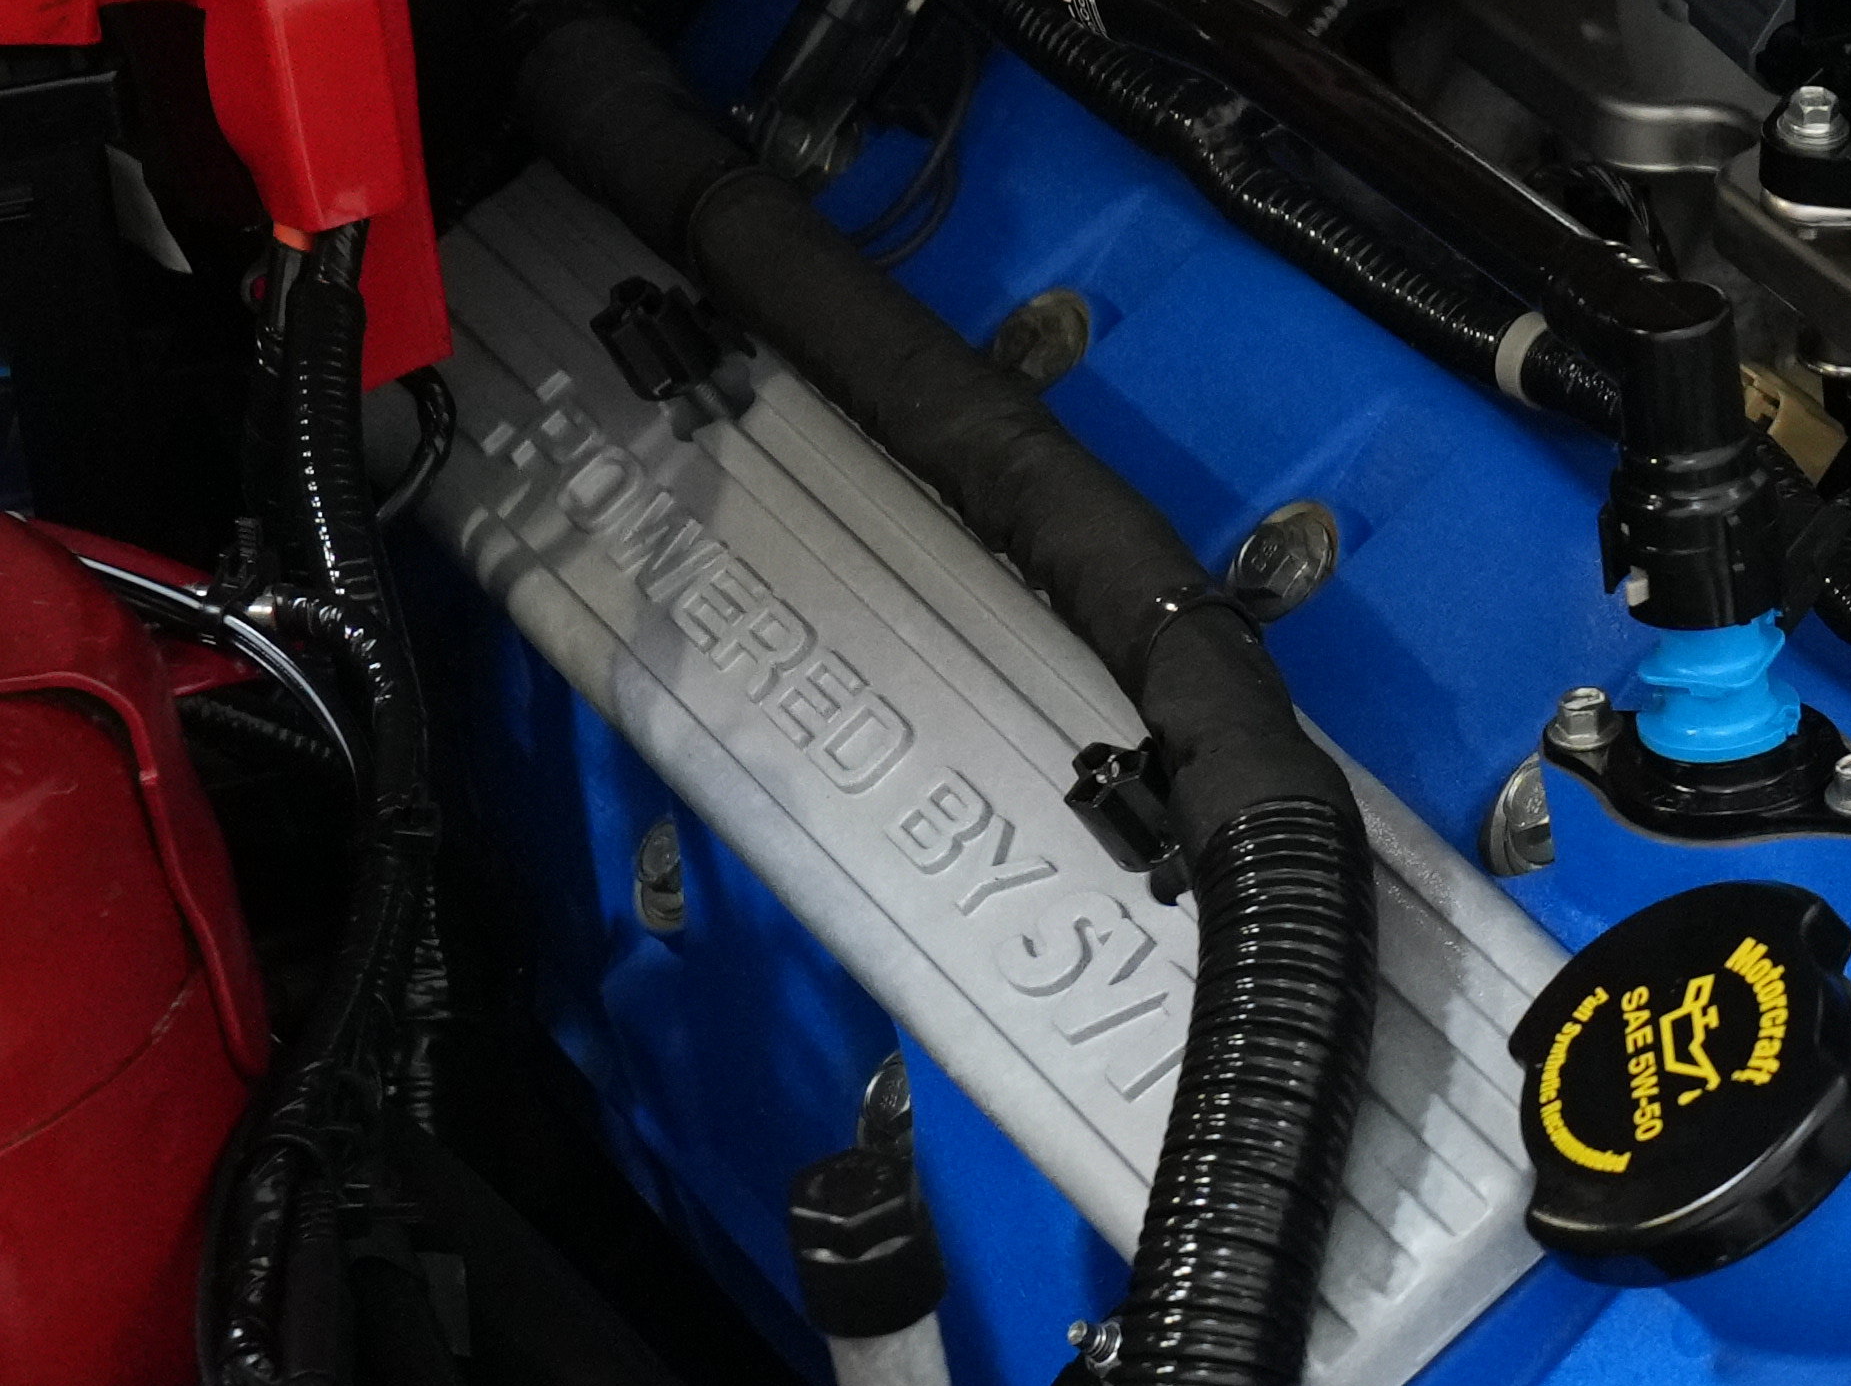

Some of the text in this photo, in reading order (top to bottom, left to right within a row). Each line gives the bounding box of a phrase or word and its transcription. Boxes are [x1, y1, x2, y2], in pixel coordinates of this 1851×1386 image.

[541, 411, 916, 795] POWERED
[885, 764, 1057, 919] BY
[1620, 985, 1664, 1142] SAE 5W-50
[1723, 936, 1789, 1086] Motorcraft
